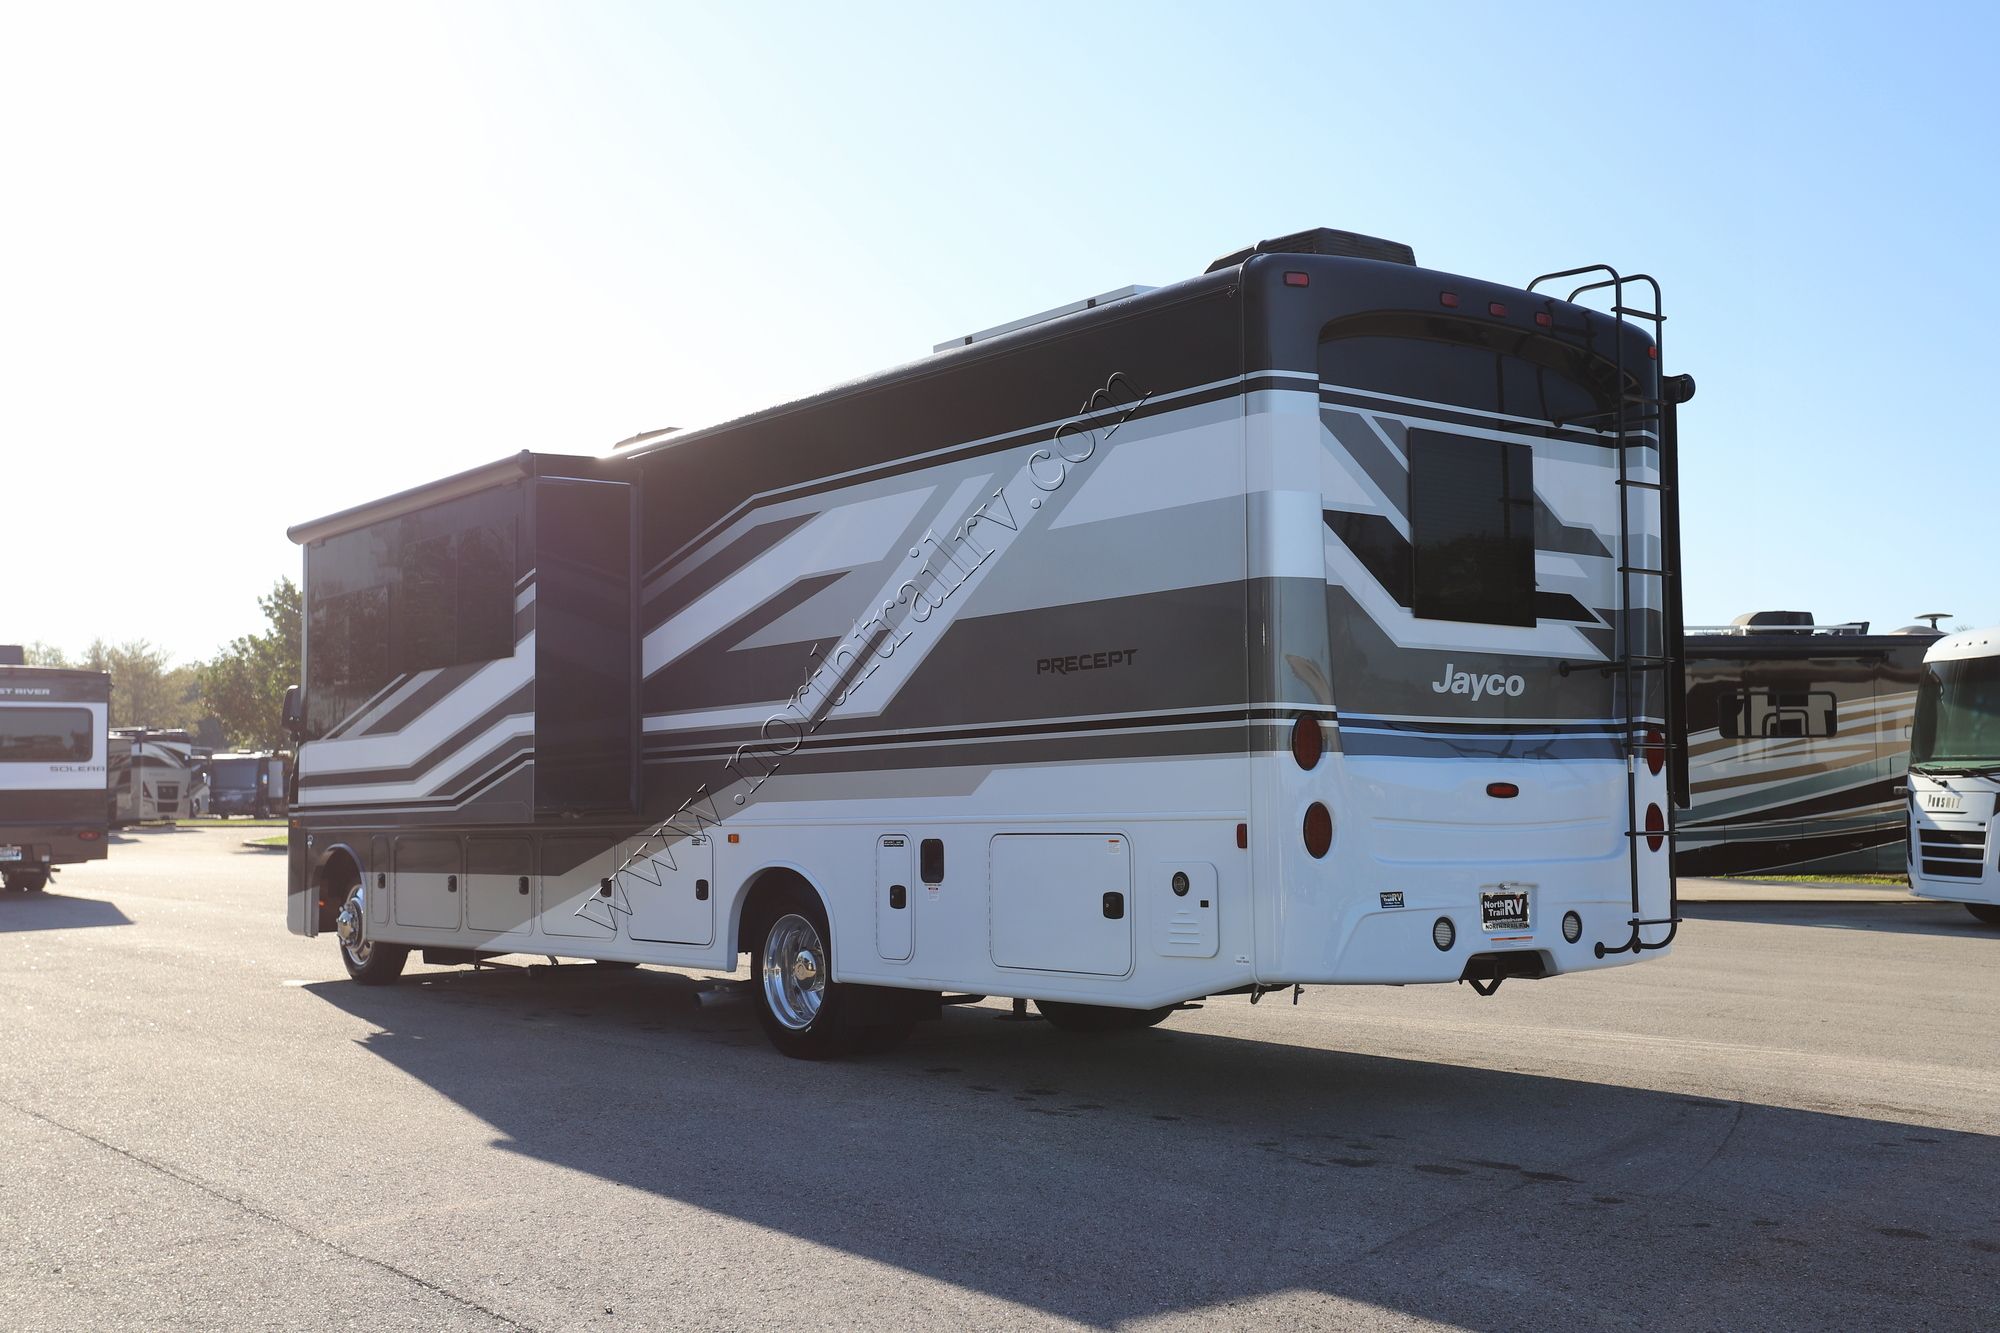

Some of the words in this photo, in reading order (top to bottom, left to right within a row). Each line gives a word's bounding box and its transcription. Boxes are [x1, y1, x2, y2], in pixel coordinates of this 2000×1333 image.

[1037, 648, 1138, 675] PRECEPT
[1432, 663, 1525, 702] Jayco
[1488, 908, 1504, 917] Trail
[1504, 899, 1523, 915] RV
